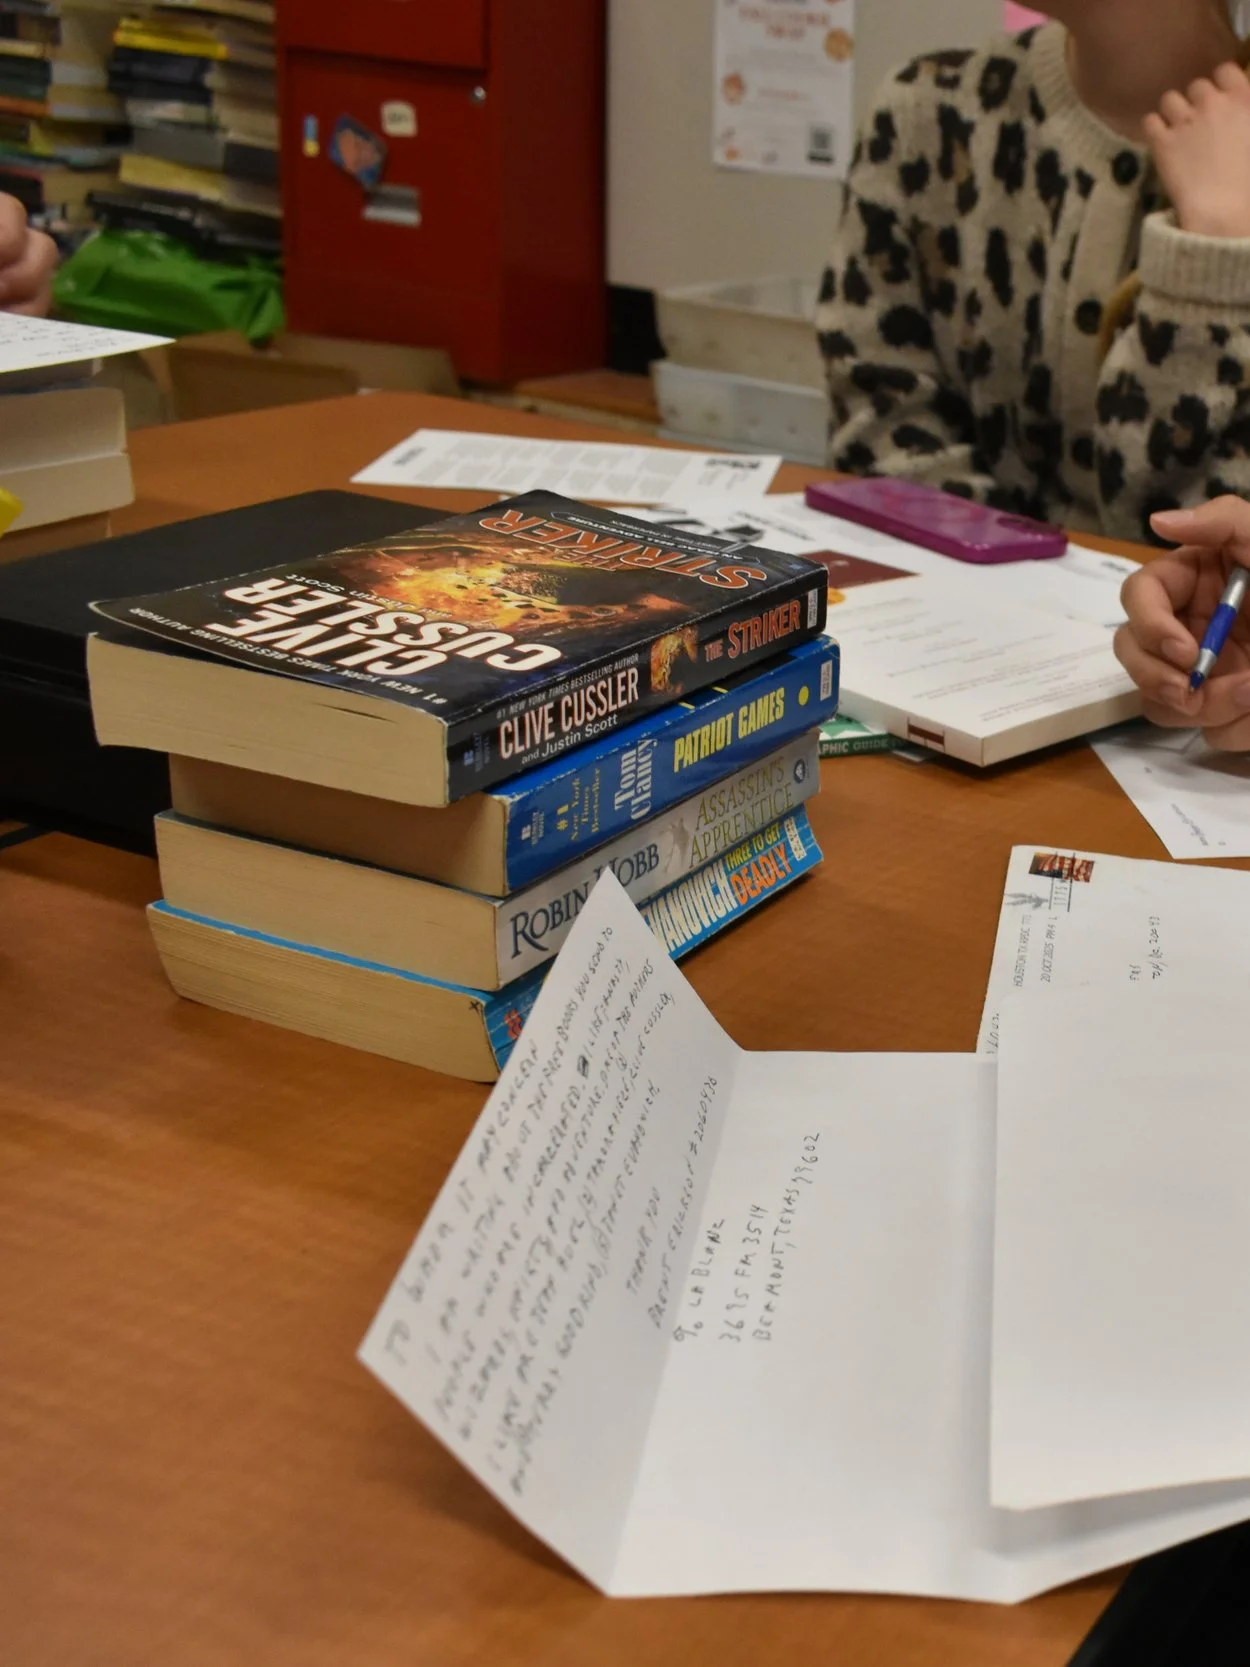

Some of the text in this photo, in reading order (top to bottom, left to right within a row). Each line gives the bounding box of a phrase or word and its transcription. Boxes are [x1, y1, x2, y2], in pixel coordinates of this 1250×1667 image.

[478, 509, 768, 589] STRIKER
[568, 516, 644, 538] ADVENTURE
[285, 573, 345, 593] Scott
[349, 590, 417, 610] Justin
[128, 607, 449, 706] #1 NEW YORK TIMES BESTSELLING AUTHOR
[204, 610, 449, 676] CLIVE
[224, 577, 562, 671] CUSSLER
[704, 641, 724, 663] THE
[727, 600, 802, 660] STRIKER
[500, 667, 639, 760] CLIVE CUSSLER
[509, 700, 526, 714] NEW
[528, 694, 546, 709] YORK
[549, 683, 569, 698] TIMES
[570, 665, 613, 691] BESTSELLING
[614, 653, 639, 672] AUTHOR
[521, 713, 618, 764] and Justin Scott
[673, 687, 785, 773] PATRIOT GAMES
[852, 738, 889, 751] GUIDE
[591, 767, 600, 833] Bestseller
[614, 749, 637, 811] Tom
[631, 739, 658, 820] Clancy
[695, 756, 785, 830] ASSASSIN'S
[689, 781, 794, 869] APPRENTICE
[725, 844, 752, 871] THREE
[753, 836, 765, 853] TO
[765, 822, 781, 844] GET
[641, 858, 738, 954] VANOVICH
[730, 842, 793, 906] DEADLY
[509, 880, 592, 960] ROBIN
[555, 998, 578, 1042] BOOKS
[574, 972, 590, 1001] YOU
[496, 1040, 537, 1127] CONCERN
[625, 1185, 660, 1291] THANK YOU
[741, 1203, 768, 1245] 3514
[733, 1253, 752, 1277] FM
